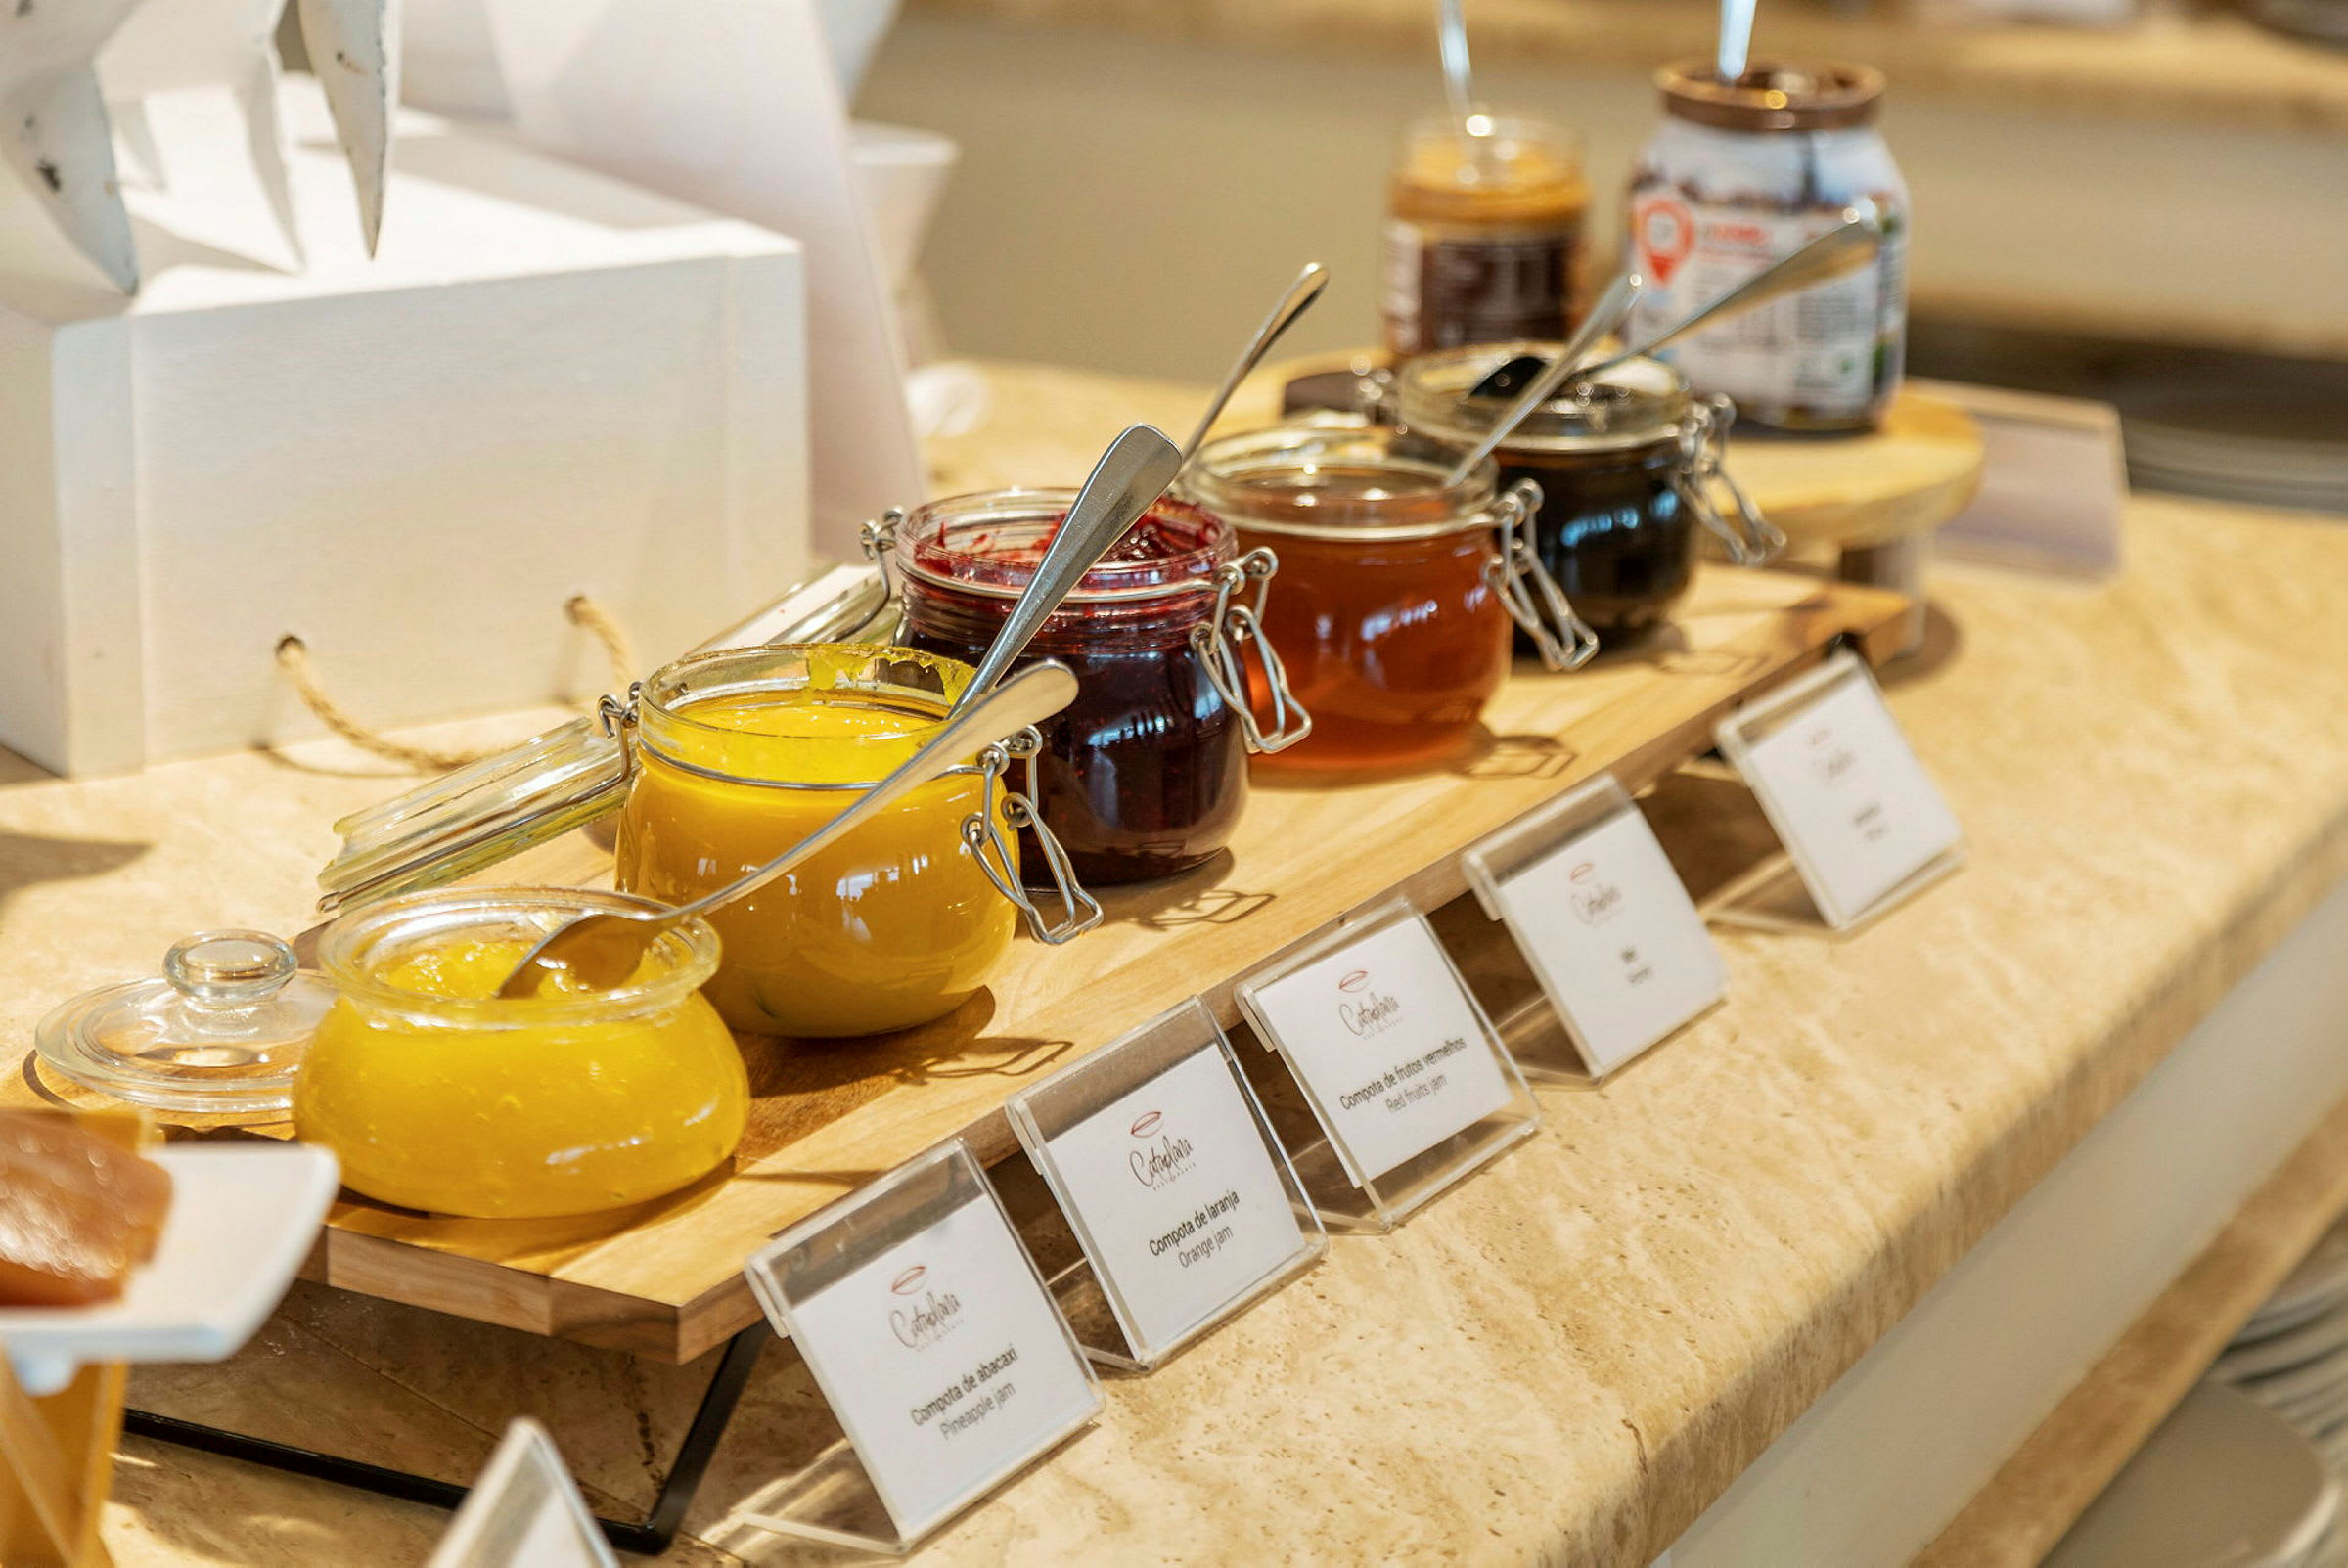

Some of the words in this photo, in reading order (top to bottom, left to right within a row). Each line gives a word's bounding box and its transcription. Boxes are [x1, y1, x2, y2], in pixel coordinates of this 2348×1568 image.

[1340, 1080, 1384, 1110] Compota
[1383, 1072, 1397, 1089] de
[1394, 1059, 1424, 1083] frutos
[1422, 1037, 1468, 1065] vermelhos
[1385, 1093, 1407, 1113] Red
[1404, 1084, 1431, 1105] fruits
[1430, 1074, 1448, 1097] jam
[1150, 1221, 1196, 1256] Compota
[1194, 1210, 1208, 1229] de
[1204, 1189, 1241, 1219] laranja
[1179, 1236, 1215, 1269] Orange
[1213, 1225, 1234, 1251] jam
[911, 1385, 963, 1426] Compota
[962, 1374, 977, 1393] de
[977, 1342, 1018, 1382] abacaxi
[939, 1396, 995, 1440] Pineapple
[993, 1382, 1016, 1410] jam
